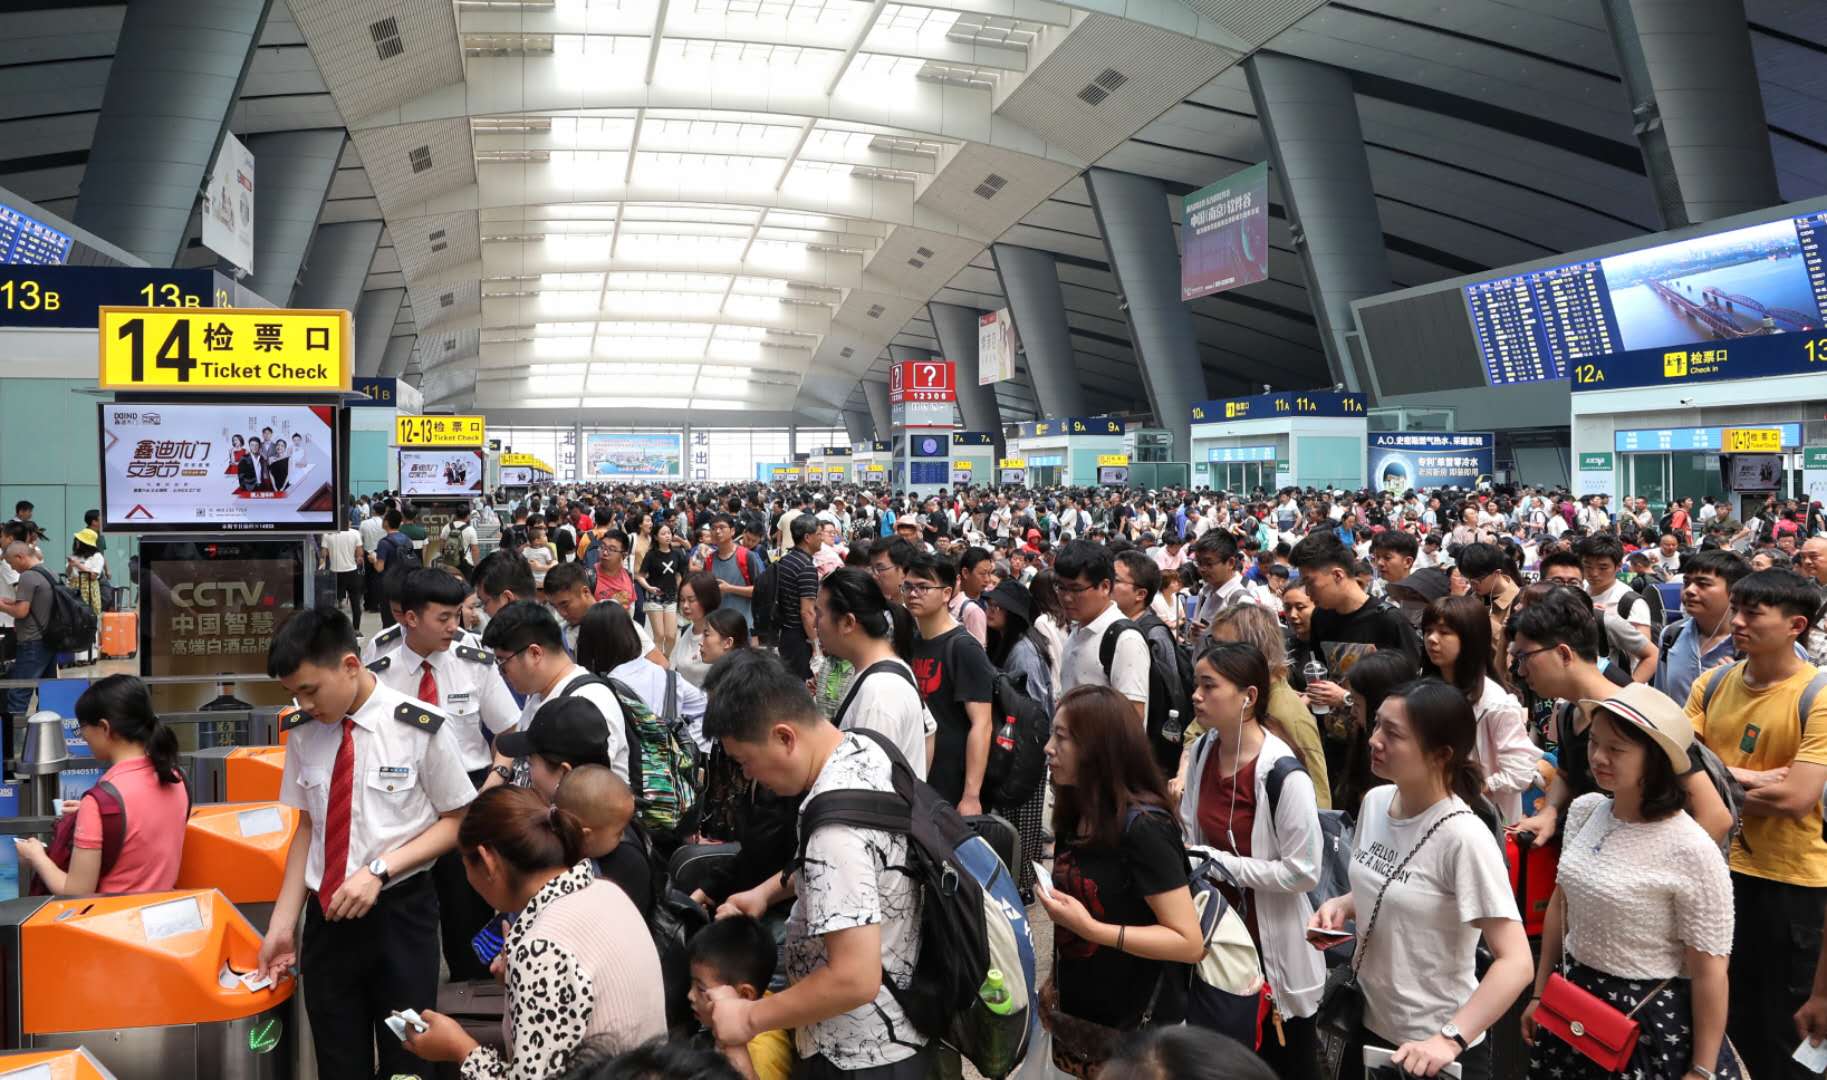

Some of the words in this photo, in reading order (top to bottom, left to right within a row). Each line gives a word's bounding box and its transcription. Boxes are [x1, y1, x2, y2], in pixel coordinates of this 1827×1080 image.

[0, 280, 60, 311] 13B
[203, 322, 330, 352] 检票口
[118, 319, 197, 382] 14
[1690, 350, 1728, 365] 检票口
[201, 363, 262, 379] Ticket
[268, 363, 328, 380] Check
[1575, 365, 1606, 384] 12A
[1690, 367, 1710, 375] Check
[363, 383, 391, 400] 11B
[913, 392, 946, 400] 12306
[1275, 399, 1290, 411] 11A
[1297, 398, 1317, 411] 11A
[1343, 398, 1363, 412] 11A
[401, 419, 433, 443] 12-13
[434, 421, 480, 433] 检票口
[1074, 421, 1087, 432] 9A
[1108, 421, 1120, 432] 9A
[134, 440, 212, 461] 鑫迪木门
[171, 611, 275, 636] 中国智慧
[1373, 859, 1395, 878] NICE
